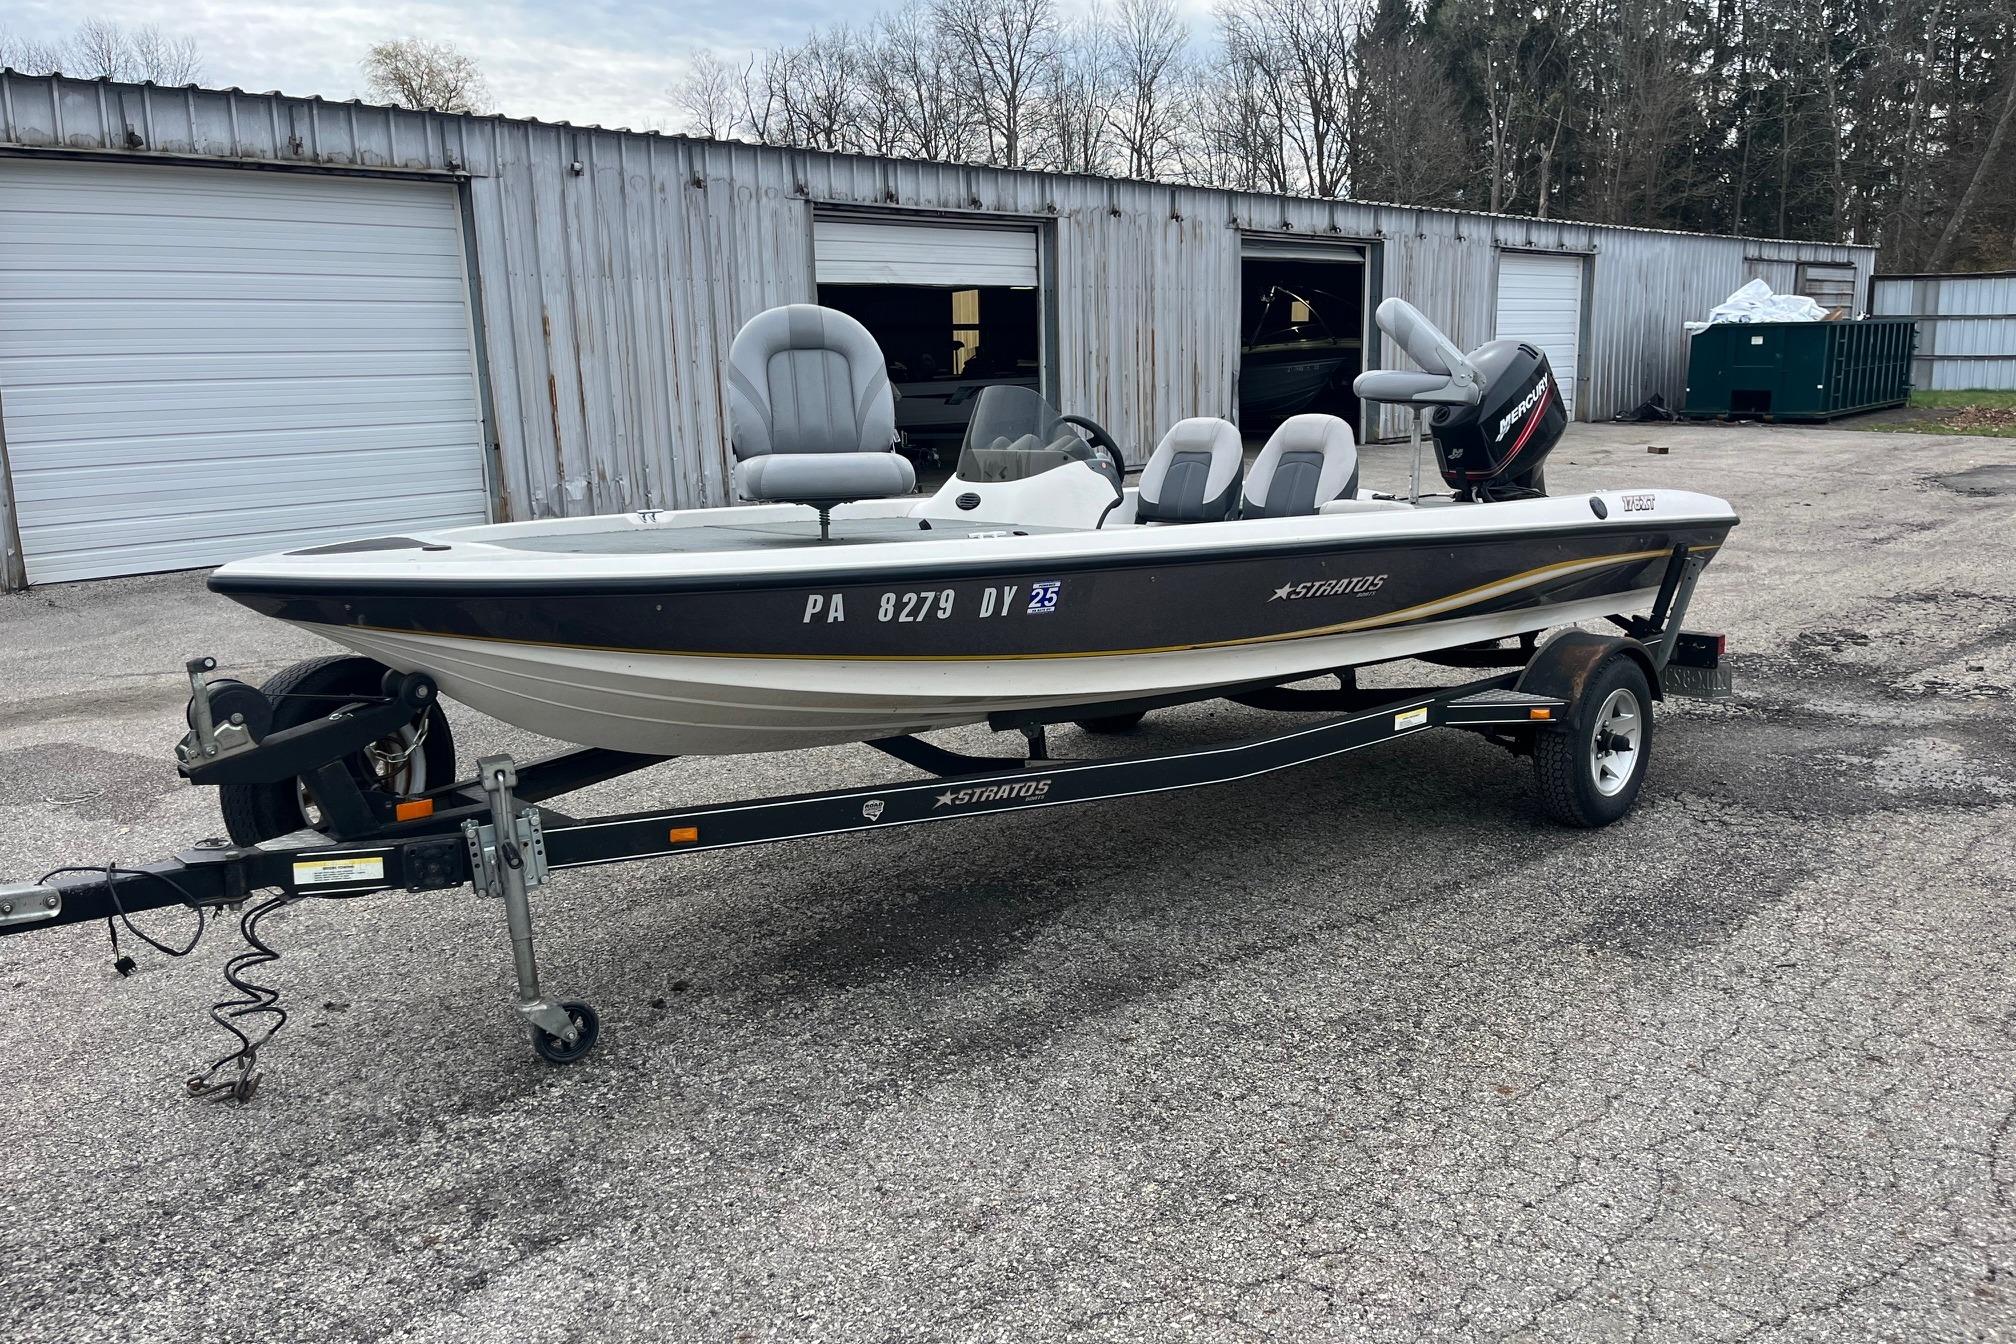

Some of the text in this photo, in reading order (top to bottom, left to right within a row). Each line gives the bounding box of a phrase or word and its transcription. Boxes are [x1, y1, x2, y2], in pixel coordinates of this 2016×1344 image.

[1496, 372, 1550, 441] MERCURY
[1028, 587, 1059, 608] 25
[1290, 574, 1389, 600] STRATOS
[803, 585, 1018, 623] PA 8279 DY
[955, 780, 1052, 804] STRATOS
